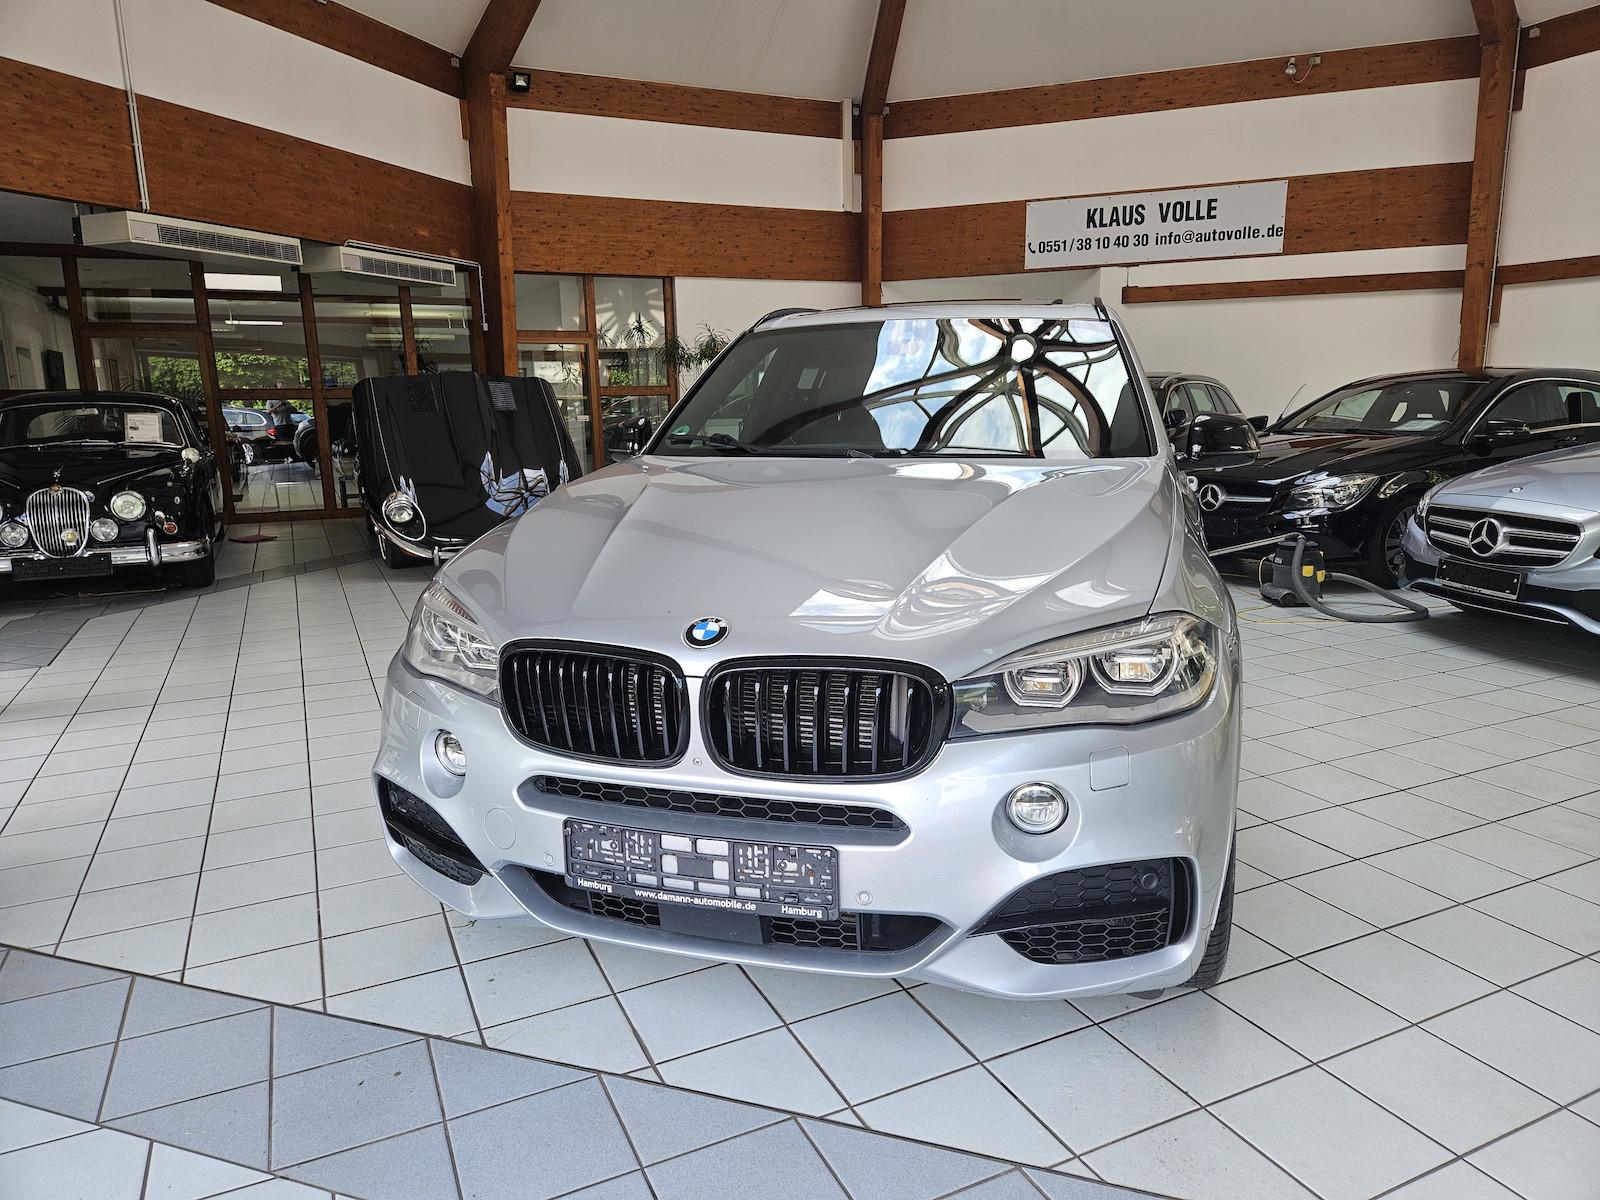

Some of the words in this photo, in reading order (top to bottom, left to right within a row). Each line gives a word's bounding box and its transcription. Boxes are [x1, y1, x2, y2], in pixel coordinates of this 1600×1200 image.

[1086, 204, 1146, 229] KLAUS
[1159, 198, 1218, 223] VOLLE
[1096, 236, 1110, 250] 10
[1113, 235, 1130, 248] 40
[1133, 233, 1149, 247] 30
[1155, 224, 1284, 246] info@autovolle.de
[577, 878, 612, 893] Hamburg
[634, 888, 756, 911] www.damann-automobile.de
[781, 905, 822, 918] Hamburg
